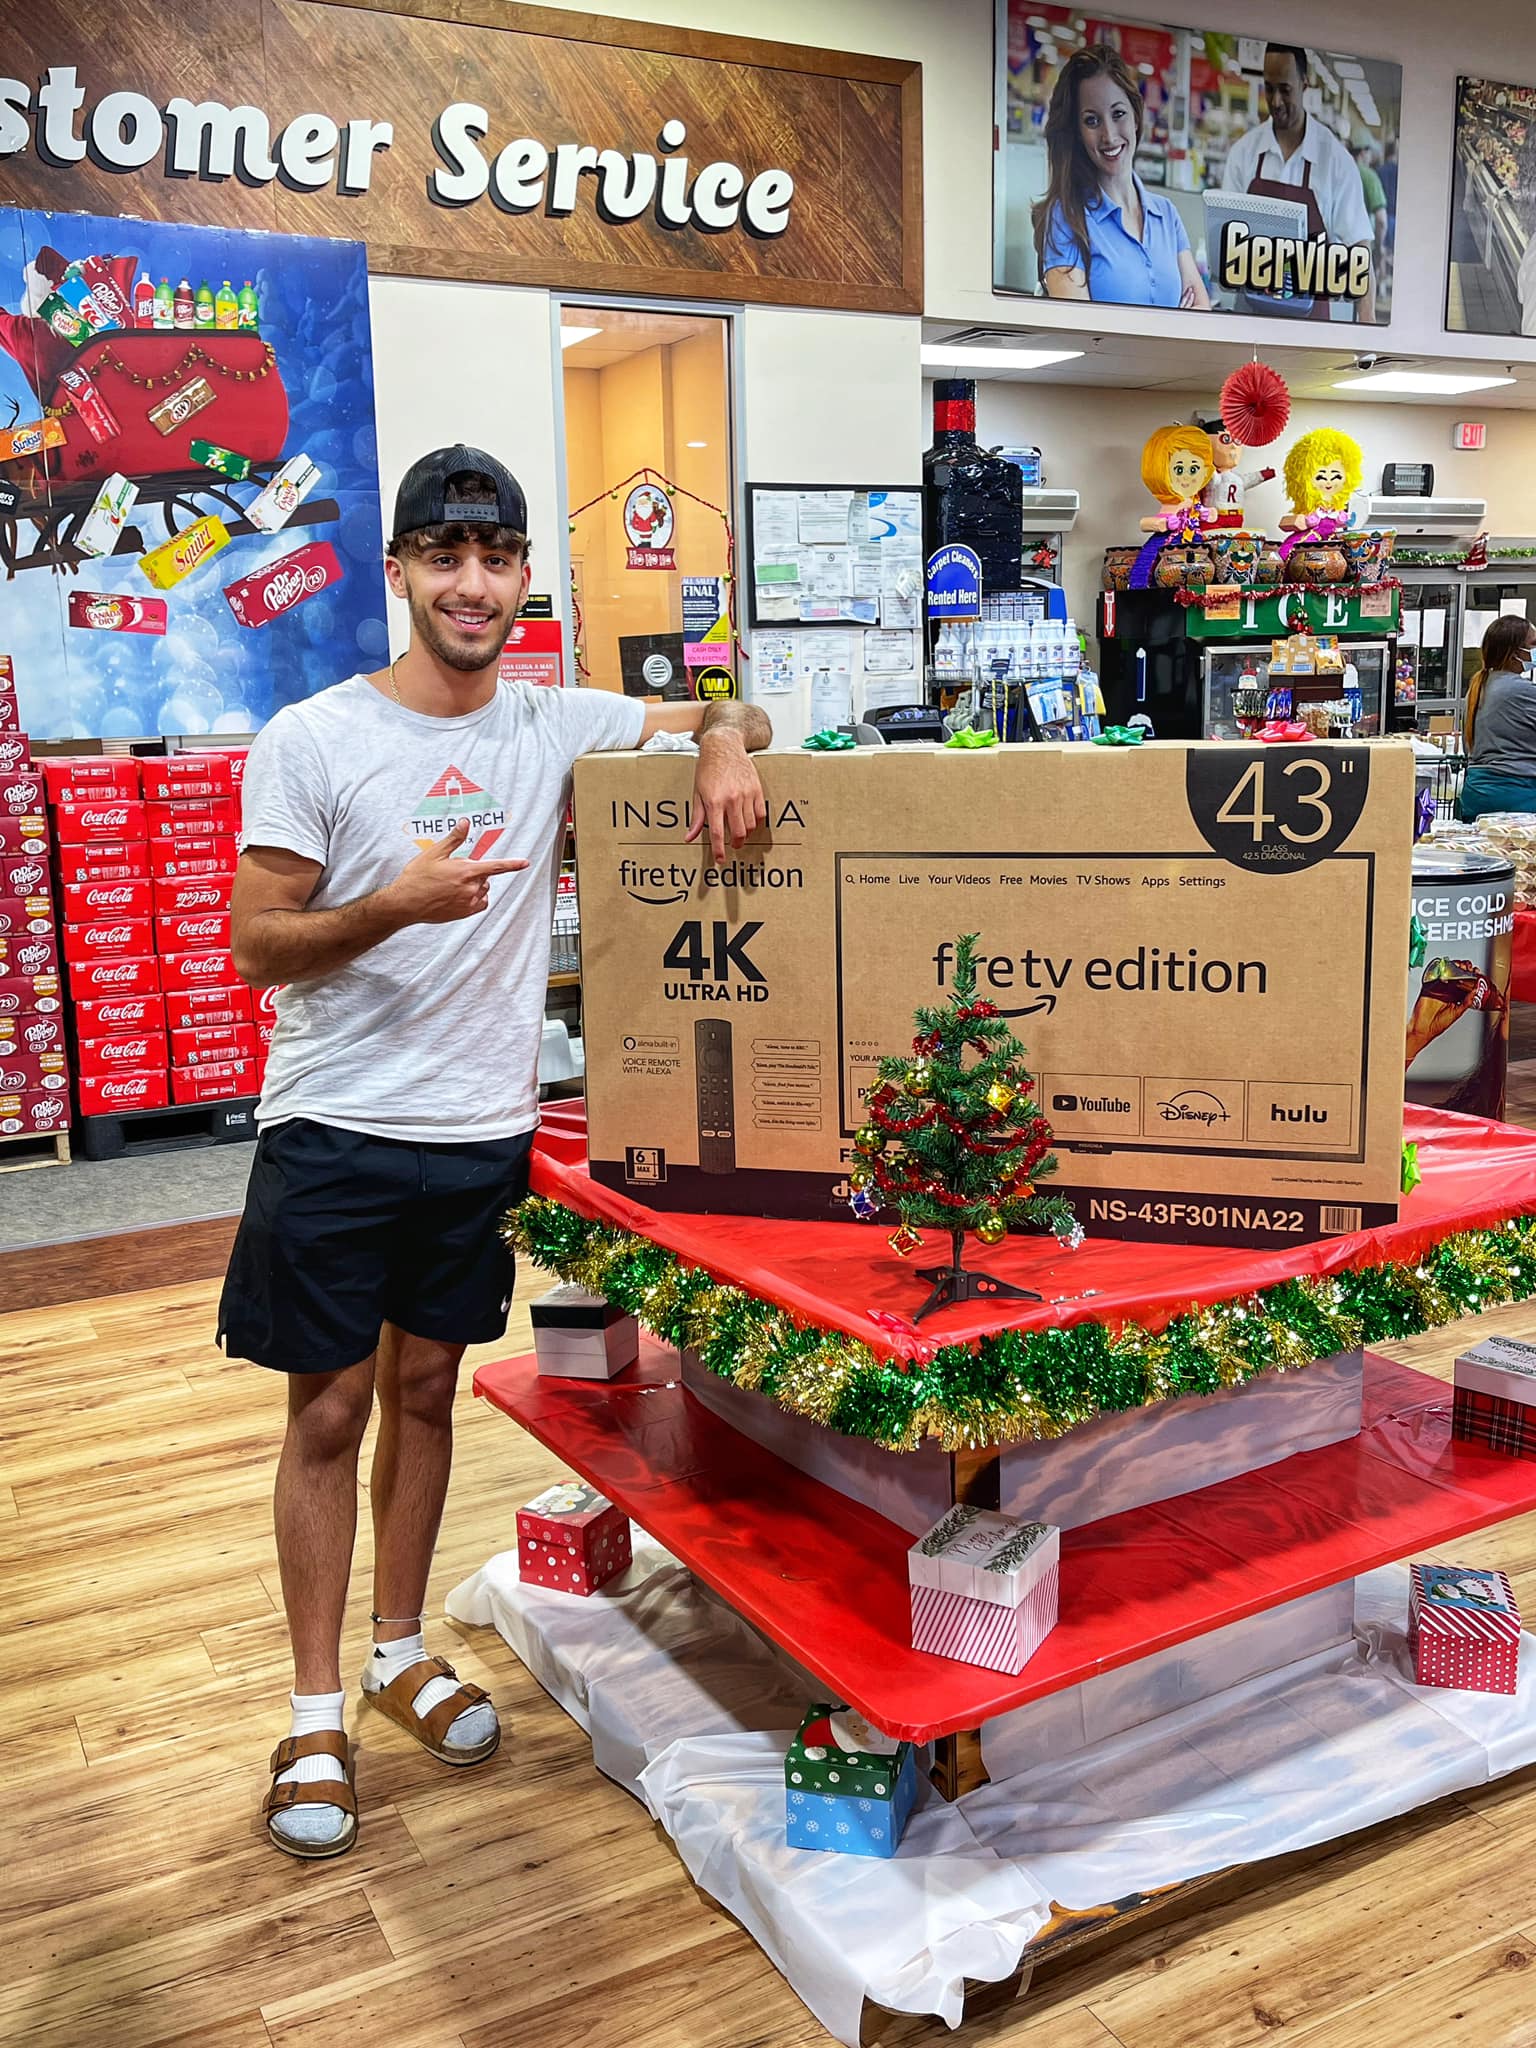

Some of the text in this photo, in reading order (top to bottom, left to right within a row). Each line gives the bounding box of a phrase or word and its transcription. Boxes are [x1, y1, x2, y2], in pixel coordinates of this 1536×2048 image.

[432, 102, 795, 236] Service
[1224, 221, 1370, 297] Service
[1463, 425, 1483, 446] EXIT
[1227, 484, 1237, 503] R
[174, 525, 215, 572] Squirt
[927, 551, 949, 580] Carpet
[952, 550, 979, 579] Cleaners
[274, 570, 290, 587] Dr
[264, 572, 301, 611] Pepper
[683, 586, 715, 597] FINAL
[928, 589, 977, 605] Rented Here
[88, 610, 123, 622] CANADA
[1242, 591, 1348, 629] ICE
[98, 617, 115, 627] DRY
[412, 811, 504, 834] THE PRCH
[612, 800, 806, 829] INSIIA
[1243, 852, 1306, 861] 42.5 DIAGONAL
[1262, 844, 1288, 852] CLASS
[703, 861, 803, 888] edition
[860, 875, 1226, 888] Home Live Your Videos Free Movies TV Shows Apps Settings
[1411, 893, 1506, 917] ICE COLD
[663, 921, 769, 982] 4K
[1085, 946, 1267, 993] edition
[664, 983, 769, 1002] ULTRA HD
[622, 1058, 681, 1067] VOICE REMOTE
[622, 1066, 672, 1075] WITH ALEXA
[6, 1077, 17, 1085] 23
[1079, 1096, 1131, 1113] YouTube
[1157, 1098, 1231, 1127] Disney+
[1271, 1104, 1328, 1124] hulu
[636, 1151, 645, 1163] 6
[1090, 1200, 1304, 1233] NS-43F301NA22
